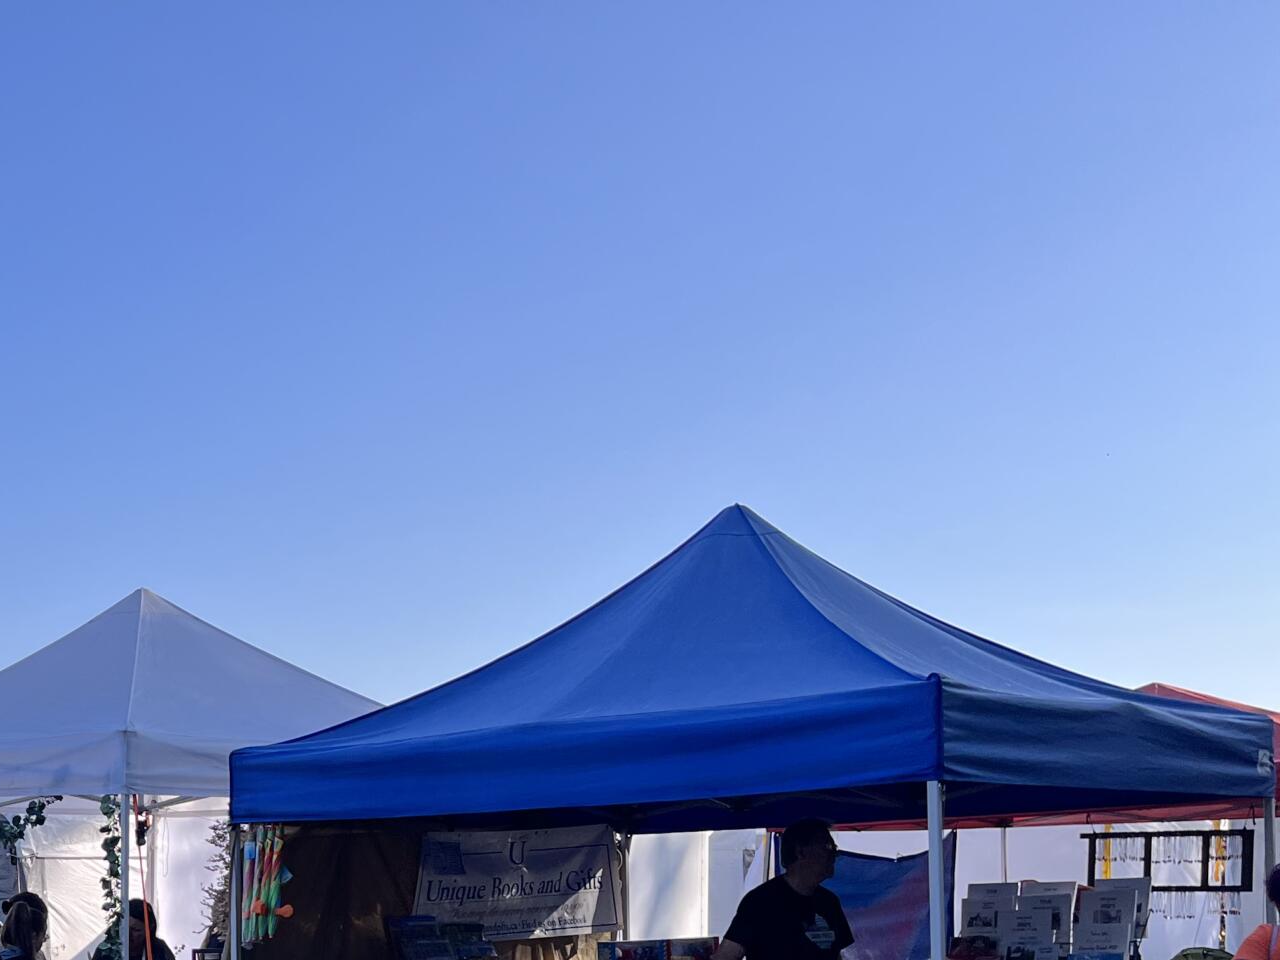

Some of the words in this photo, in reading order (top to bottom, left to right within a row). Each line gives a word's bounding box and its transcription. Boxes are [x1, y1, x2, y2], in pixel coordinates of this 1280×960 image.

[509, 840, 526, 865] U
[426, 879, 487, 907] Unique
[491, 874, 534, 898] Books
[537, 872, 563, 894] and
[565, 868, 604, 892] Gifts
